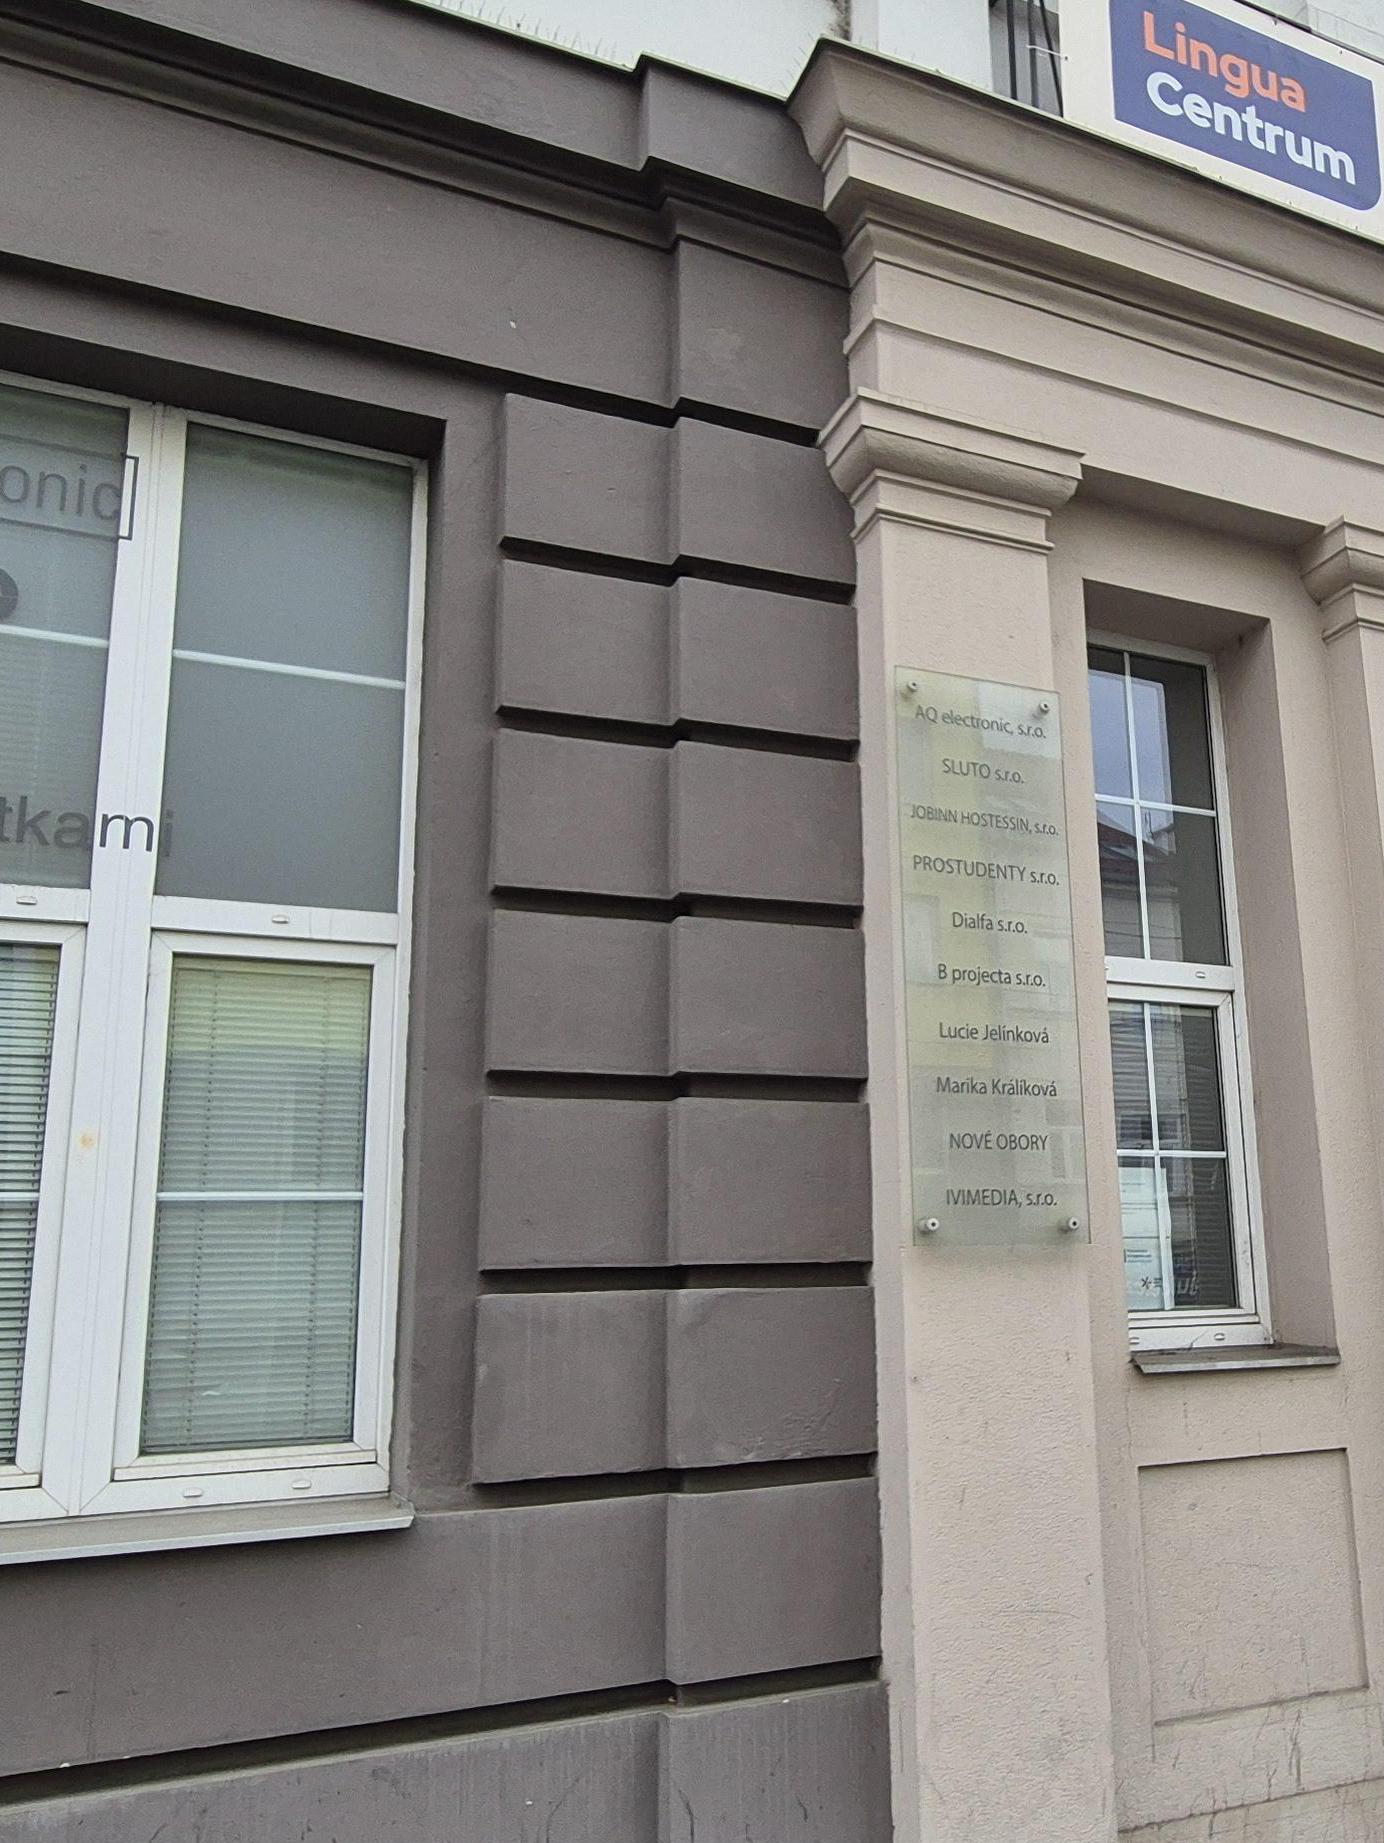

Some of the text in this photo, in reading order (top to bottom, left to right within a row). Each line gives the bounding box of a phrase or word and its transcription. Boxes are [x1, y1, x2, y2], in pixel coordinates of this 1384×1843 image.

[1143, 11, 1306, 113] Lingua
[1146, 72, 1356, 186] Centrum
[914, 704, 1047, 739] AQ electronic, s.r.o.
[941, 758, 1025, 784] SLUTO s.r.o.
[910, 804, 1060, 836] JOBINN HOSTESSIN, s.r.o.
[912, 854, 1060, 886] PROSTUDENTY s.r.o.
[951, 911, 1028, 934] Dialfa s.r.o.
[937, 963, 1046, 987] B projecta s.r.o.
[939, 1022, 1049, 1044] Lucie Jelínková
[936, 1076, 988, 1095] Marika
[950, 1130, 1049, 1151] NOVÉ OBORY
[946, 1188, 1058, 1209] IVIMEDIA, s.r.o.
